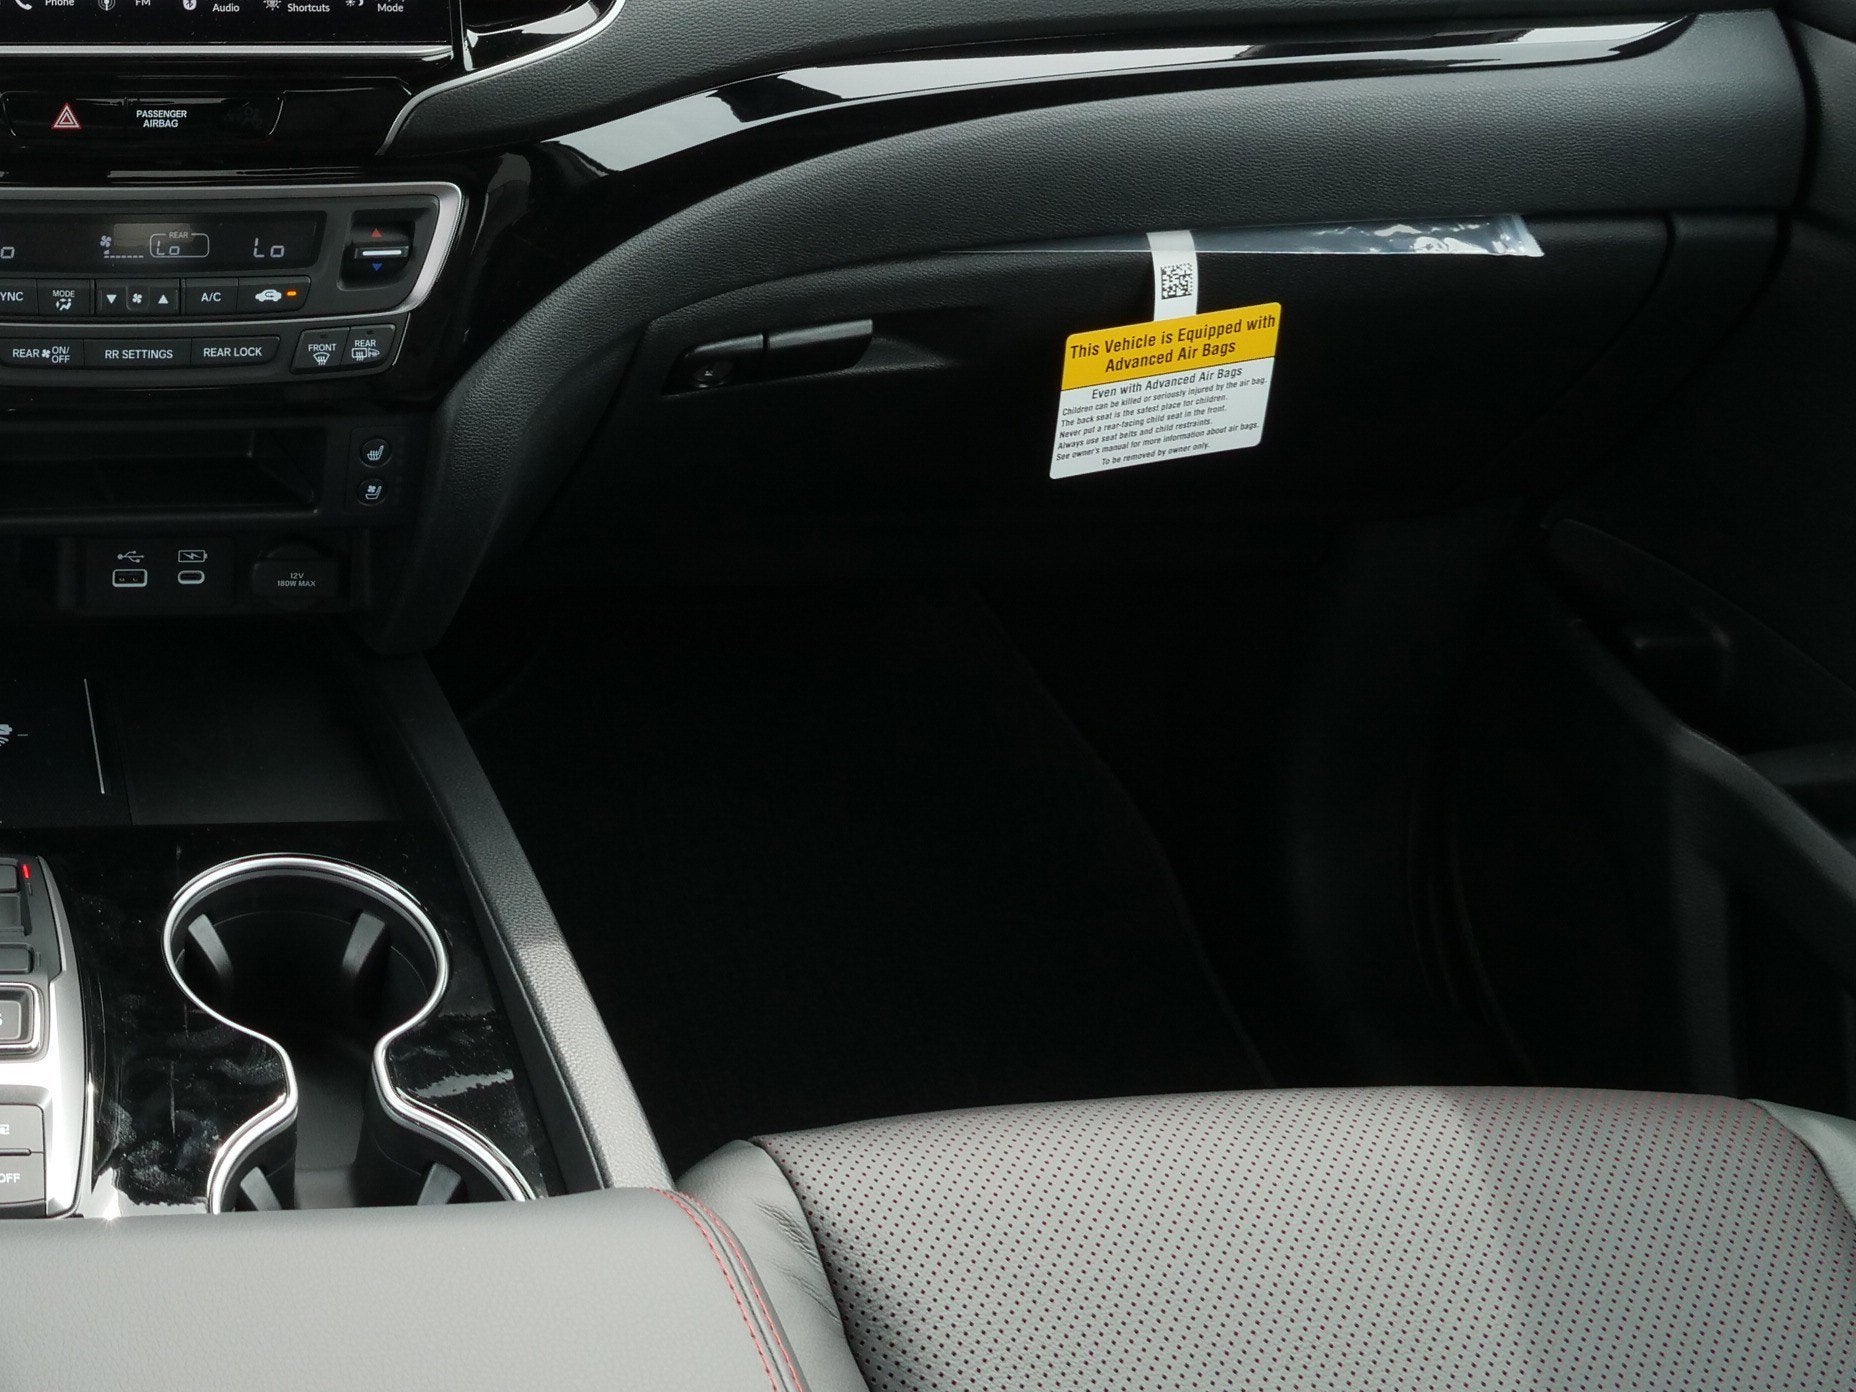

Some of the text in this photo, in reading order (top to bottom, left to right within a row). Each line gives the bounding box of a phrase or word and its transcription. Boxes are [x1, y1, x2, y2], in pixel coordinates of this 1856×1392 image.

[212, 3, 240, 12] Audio
[287, 3, 331, 13] Shortcuts
[377, 3, 404, 12] Mode
[136, 110, 188, 118] PASSENGER
[142, 119, 179, 128] AIRBAG
[168, 231, 189, 239] REAR
[156, 240, 180, 256] Lo
[252, 237, 285, 258] Lo
[52, 290, 76, 298] MODE
[200, 292, 222, 303] A/C
[1070, 314, 1276, 359] This Vehicle is Equipped with
[308, 343, 337, 352] FRONT
[354, 339, 377, 348] REAR
[12, 346, 70, 358] REAR ON/
[104, 349, 174, 360] RR SETTINGS
[203, 346, 262, 358] REAR LOCK
[1105, 340, 1236, 373] Advanced Air Bags
[51, 355, 71, 364] OFF
[1092, 367, 1243, 400] Even with Advanced Air Bags
[1062, 405, 1094, 416] Children
[1094, 402, 1108, 410] can
[1110, 400, 1120, 408] be
[1121, 396, 1142, 406] killed
[1152, 389, 1187, 402] seriously
[1188, 384, 1214, 396] injured
[1216, 384, 1225, 392] by
[1226, 380, 1238, 389] the
[1239, 379, 1250, 387] air
[1252, 377, 1268, 386] bag.
[290, 572, 304, 580] 12V
